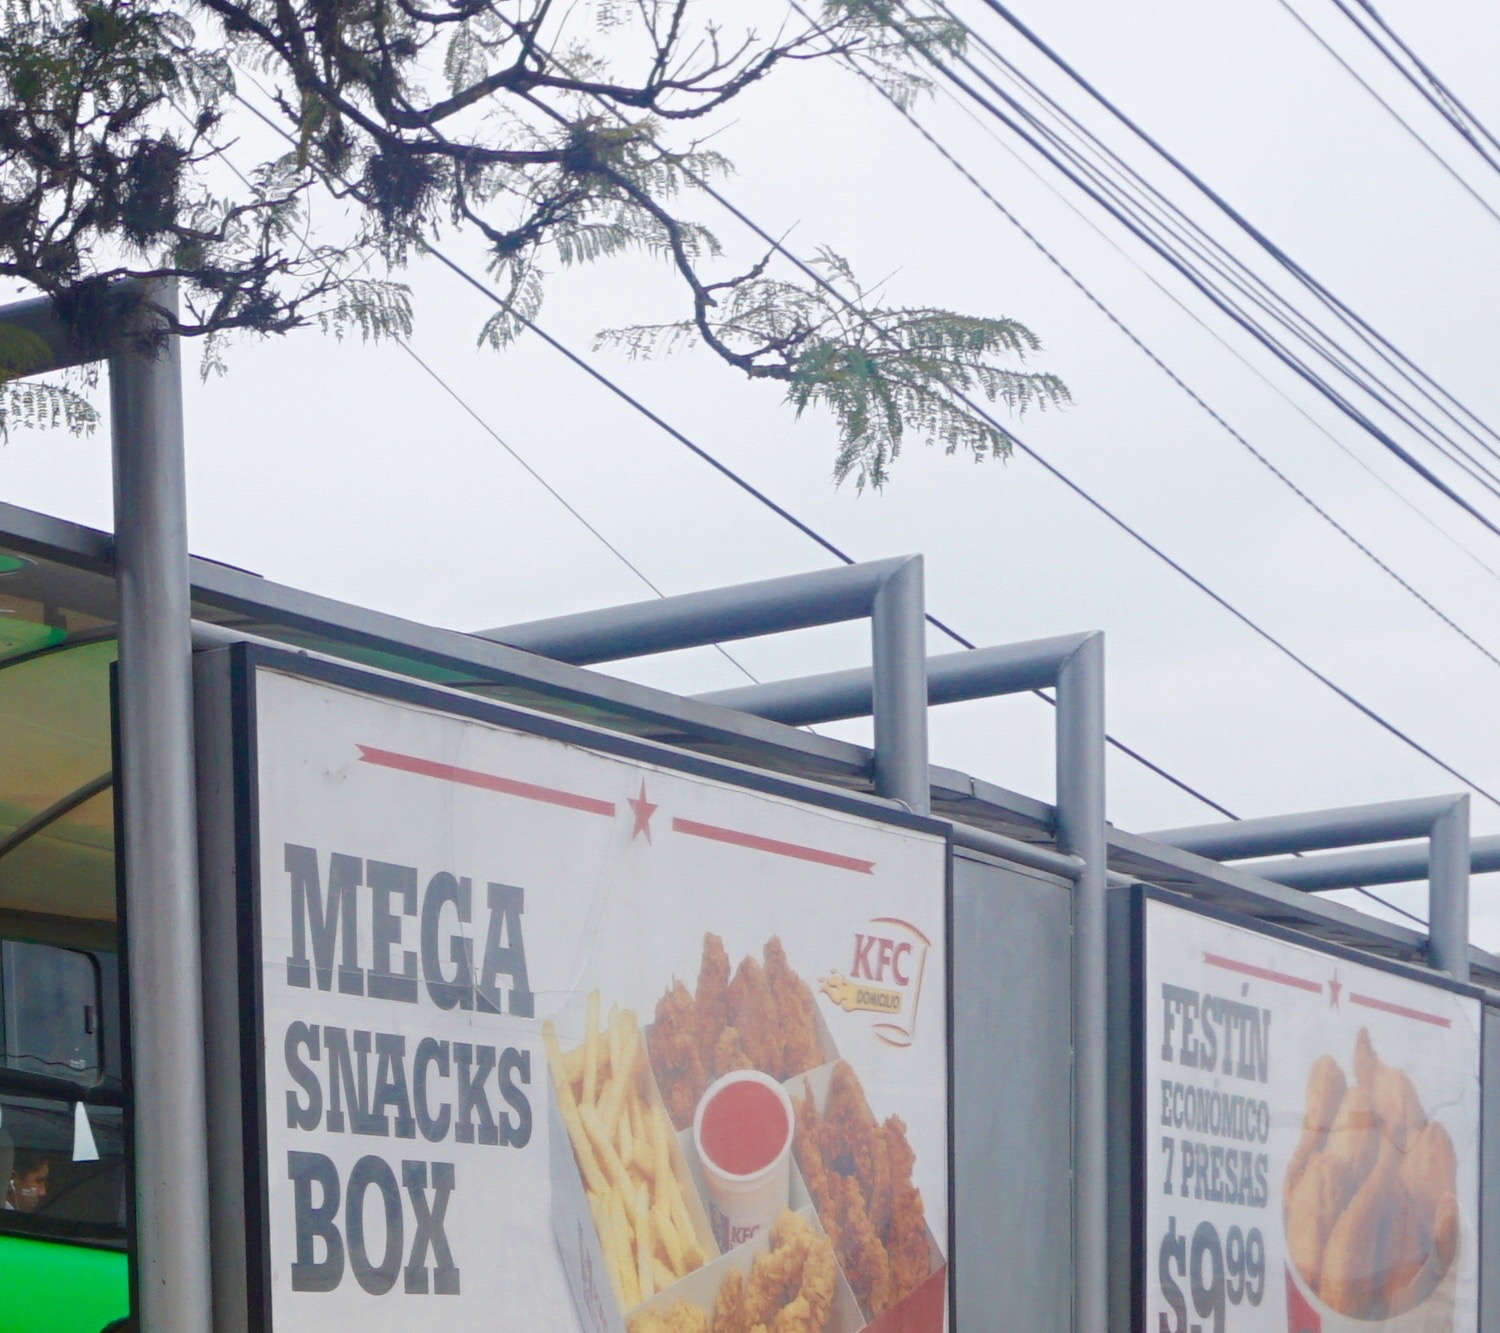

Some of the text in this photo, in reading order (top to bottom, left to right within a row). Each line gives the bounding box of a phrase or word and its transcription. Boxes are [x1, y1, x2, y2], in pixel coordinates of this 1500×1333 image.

[285, 843, 534, 1019] MEGA
[850, 933, 914, 987] KFC
[285, 1020, 532, 1149] SNACKS
[1161, 982, 1271, 1084] FESTÍN
[287, 1151, 460, 1296] BOX
[1161, 1136, 1268, 1209] 7 PRESAS
